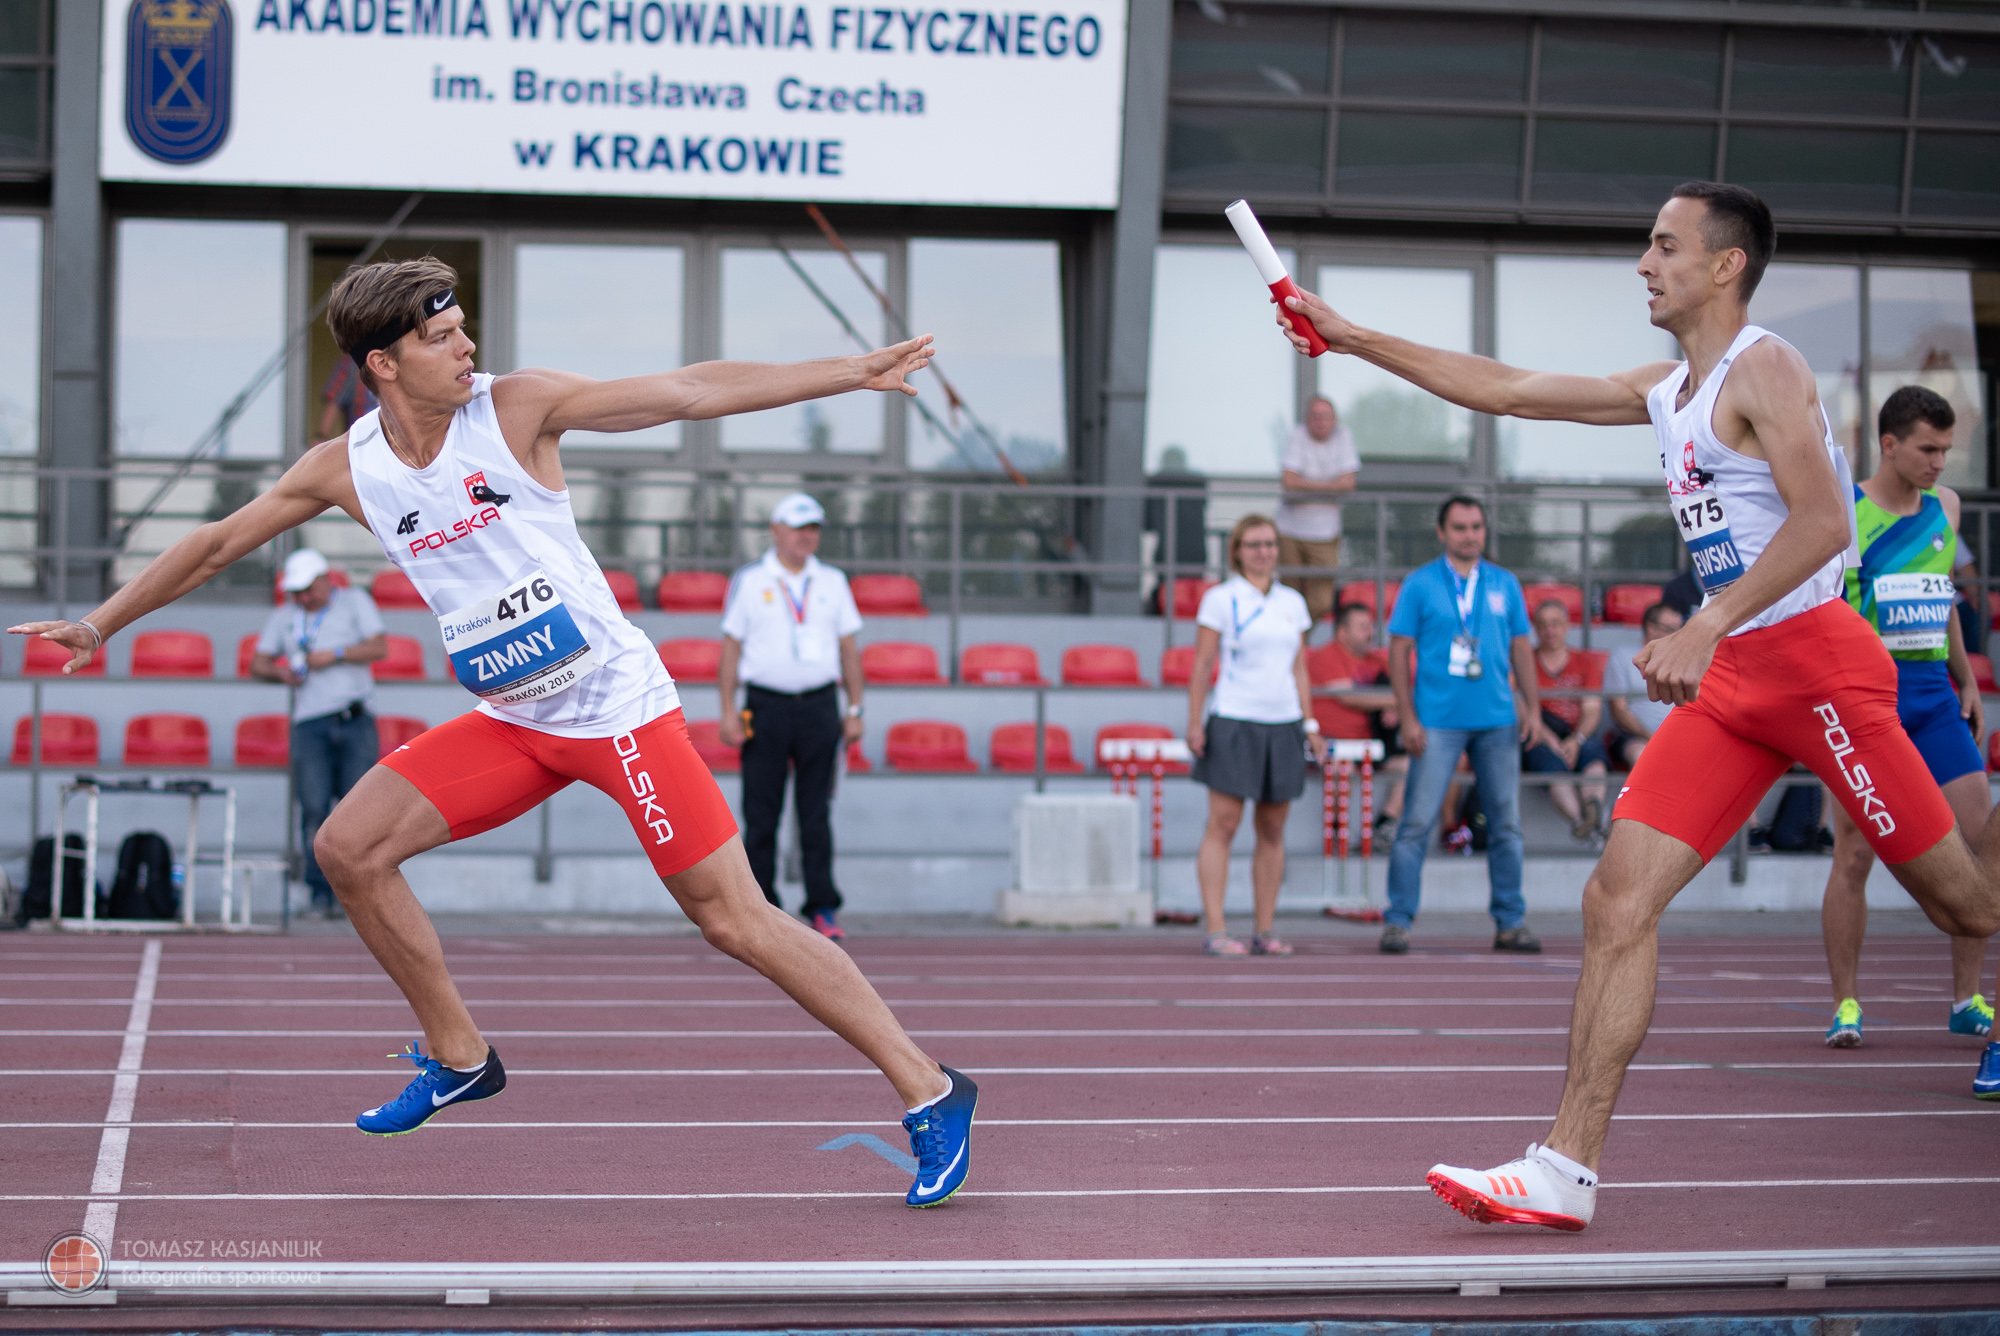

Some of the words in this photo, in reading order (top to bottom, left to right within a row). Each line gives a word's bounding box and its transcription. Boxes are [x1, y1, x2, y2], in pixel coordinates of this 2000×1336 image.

[255, 0, 490, 38] AKADEMIA
[507, 0, 813, 48] WYCHOWANIA
[831, 7, 1101, 59] FIZYCZNEGO
[434, 67, 494, 101] im.
[513, 69, 746, 109] Bronisława
[777, 77, 924, 114] Czecha
[514, 141, 553, 167] w
[573, 133, 842, 176] KRAKOWIE
[464, 473, 482, 484] POLSKA
[409, 507, 501, 558] POLSKA
[1680, 498, 1723, 531] 475
[497, 578, 553, 621] 476
[456, 615, 491, 635] Kraków
[469, 624, 555, 682] ZIMNY
[502, 684, 546, 703] KRAKÓW
[547, 670, 575, 689] 2018
[1813, 702, 1896, 837] POLSKA
